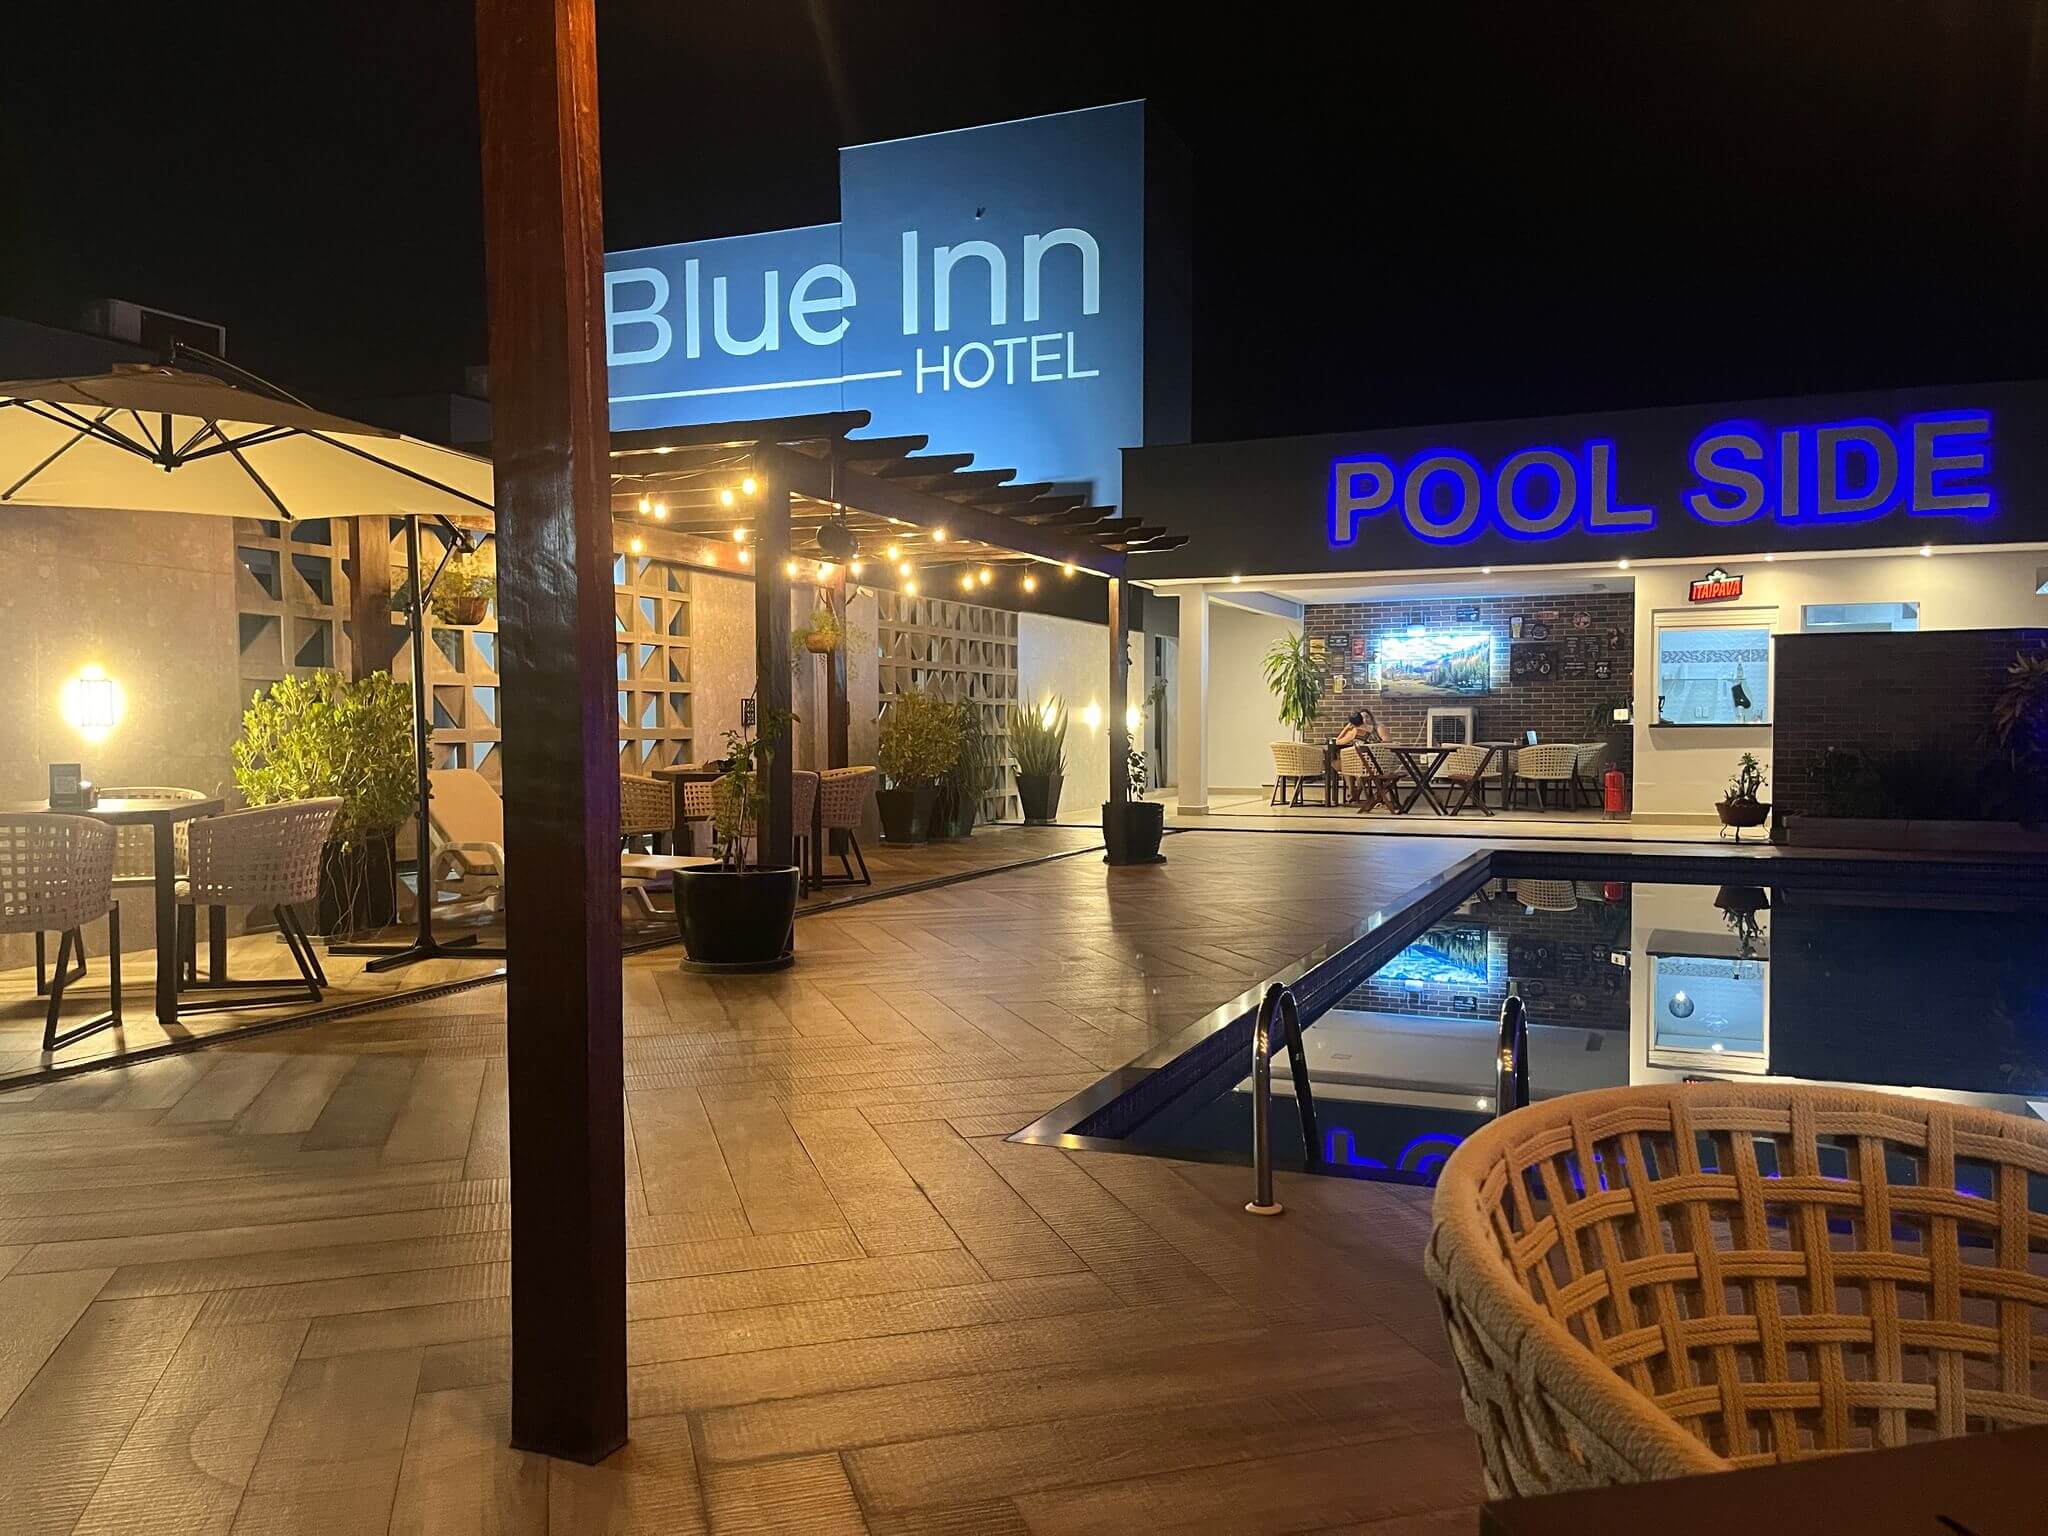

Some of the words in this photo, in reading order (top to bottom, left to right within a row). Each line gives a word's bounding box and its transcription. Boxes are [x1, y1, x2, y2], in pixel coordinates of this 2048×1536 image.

[603, 258, 857, 367] Blue
[902, 227, 1101, 336] Inn
[916, 331, 1100, 394] HOTEL
[1334, 444, 1652, 541] POOL
[1690, 418, 1991, 522] SIDE
[1691, 580, 1741, 600] ITAIPAVA
